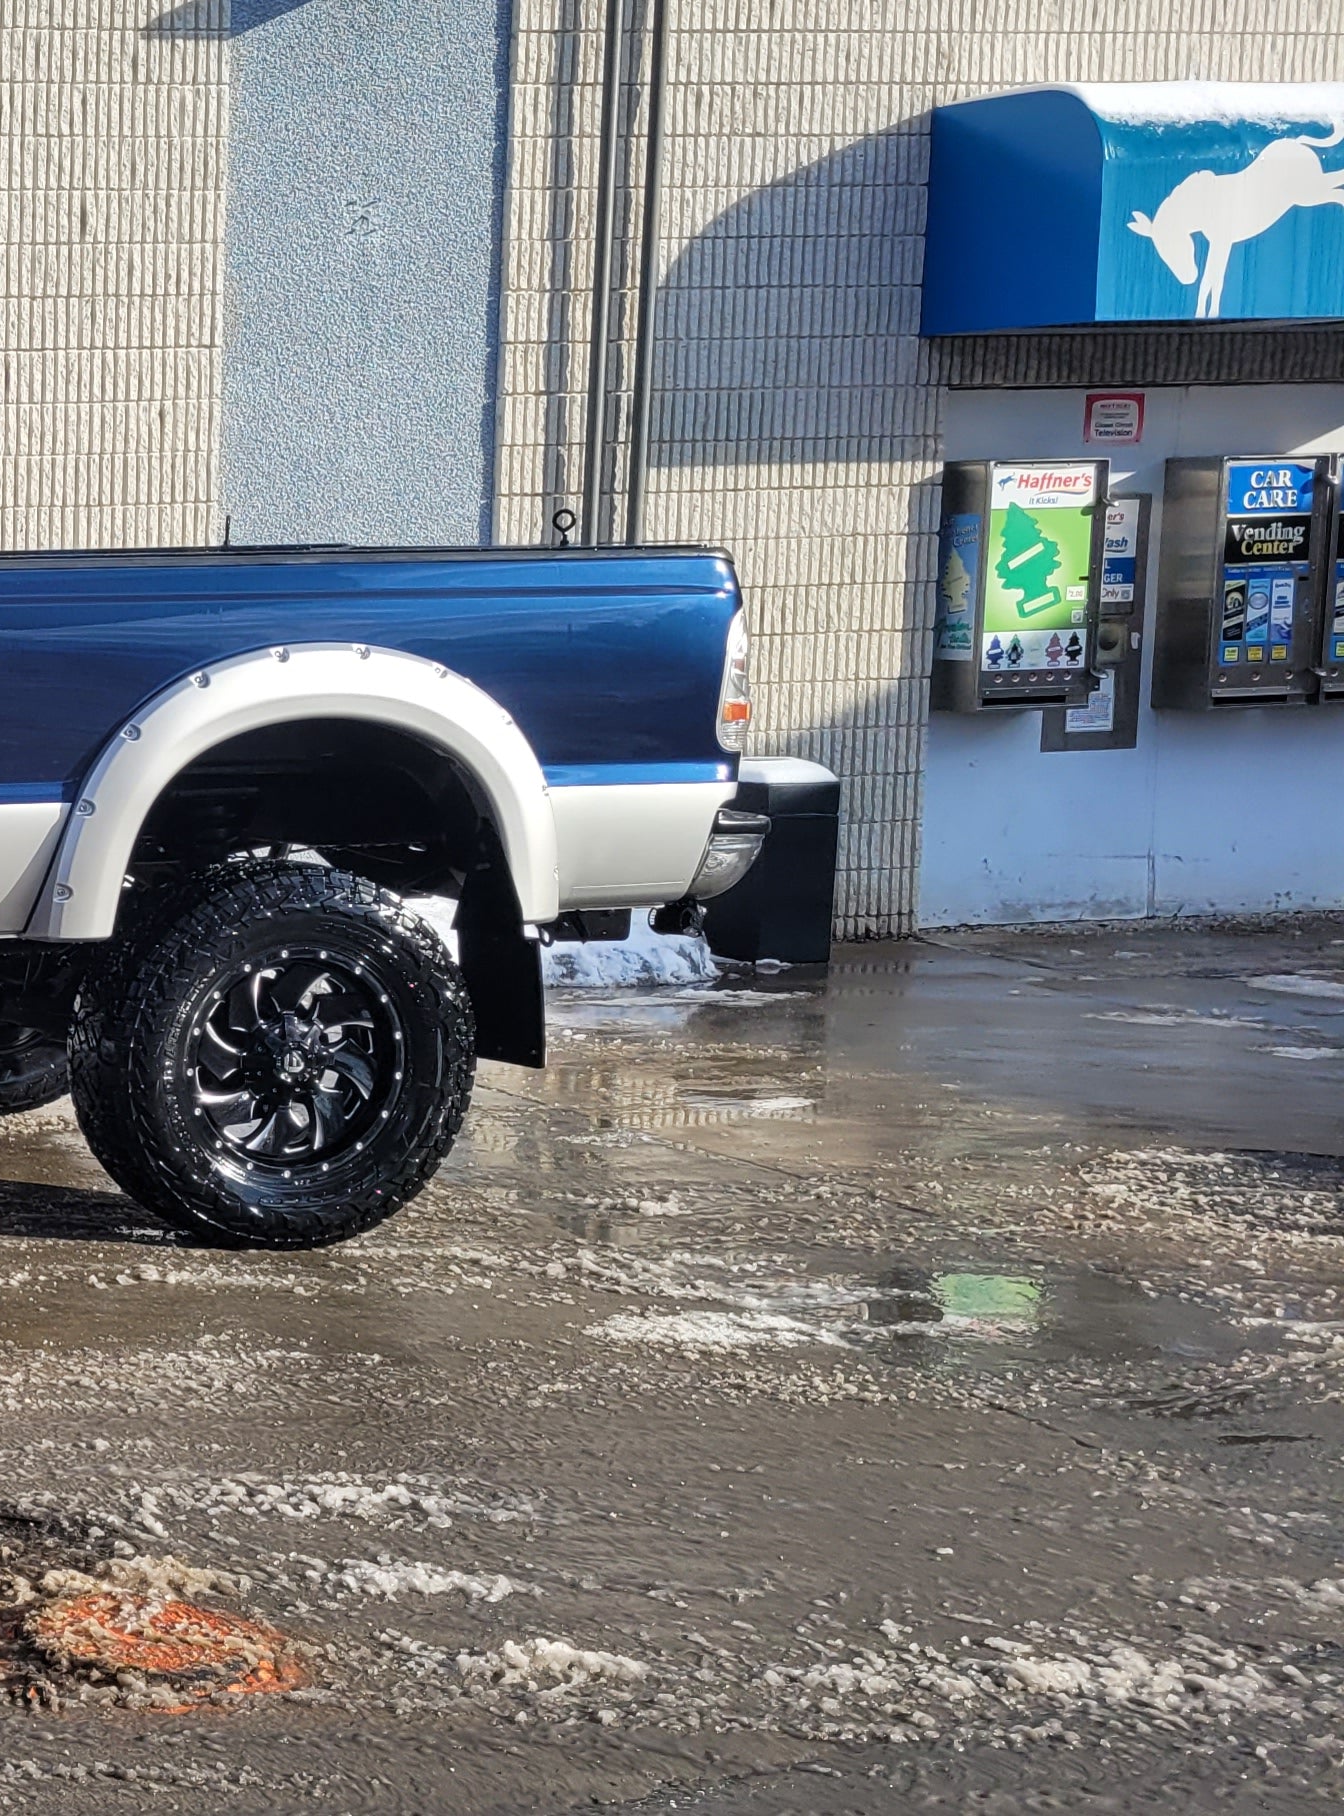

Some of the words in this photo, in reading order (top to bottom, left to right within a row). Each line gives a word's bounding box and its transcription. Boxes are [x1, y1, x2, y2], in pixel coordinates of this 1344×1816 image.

[1017, 472, 1092, 491] Haffner's
[1251, 469, 1293, 489] CAR
[1243, 490, 1298, 510] CARE
[1231, 522, 1306, 544] Vending
[1241, 540, 1295, 556] Center
